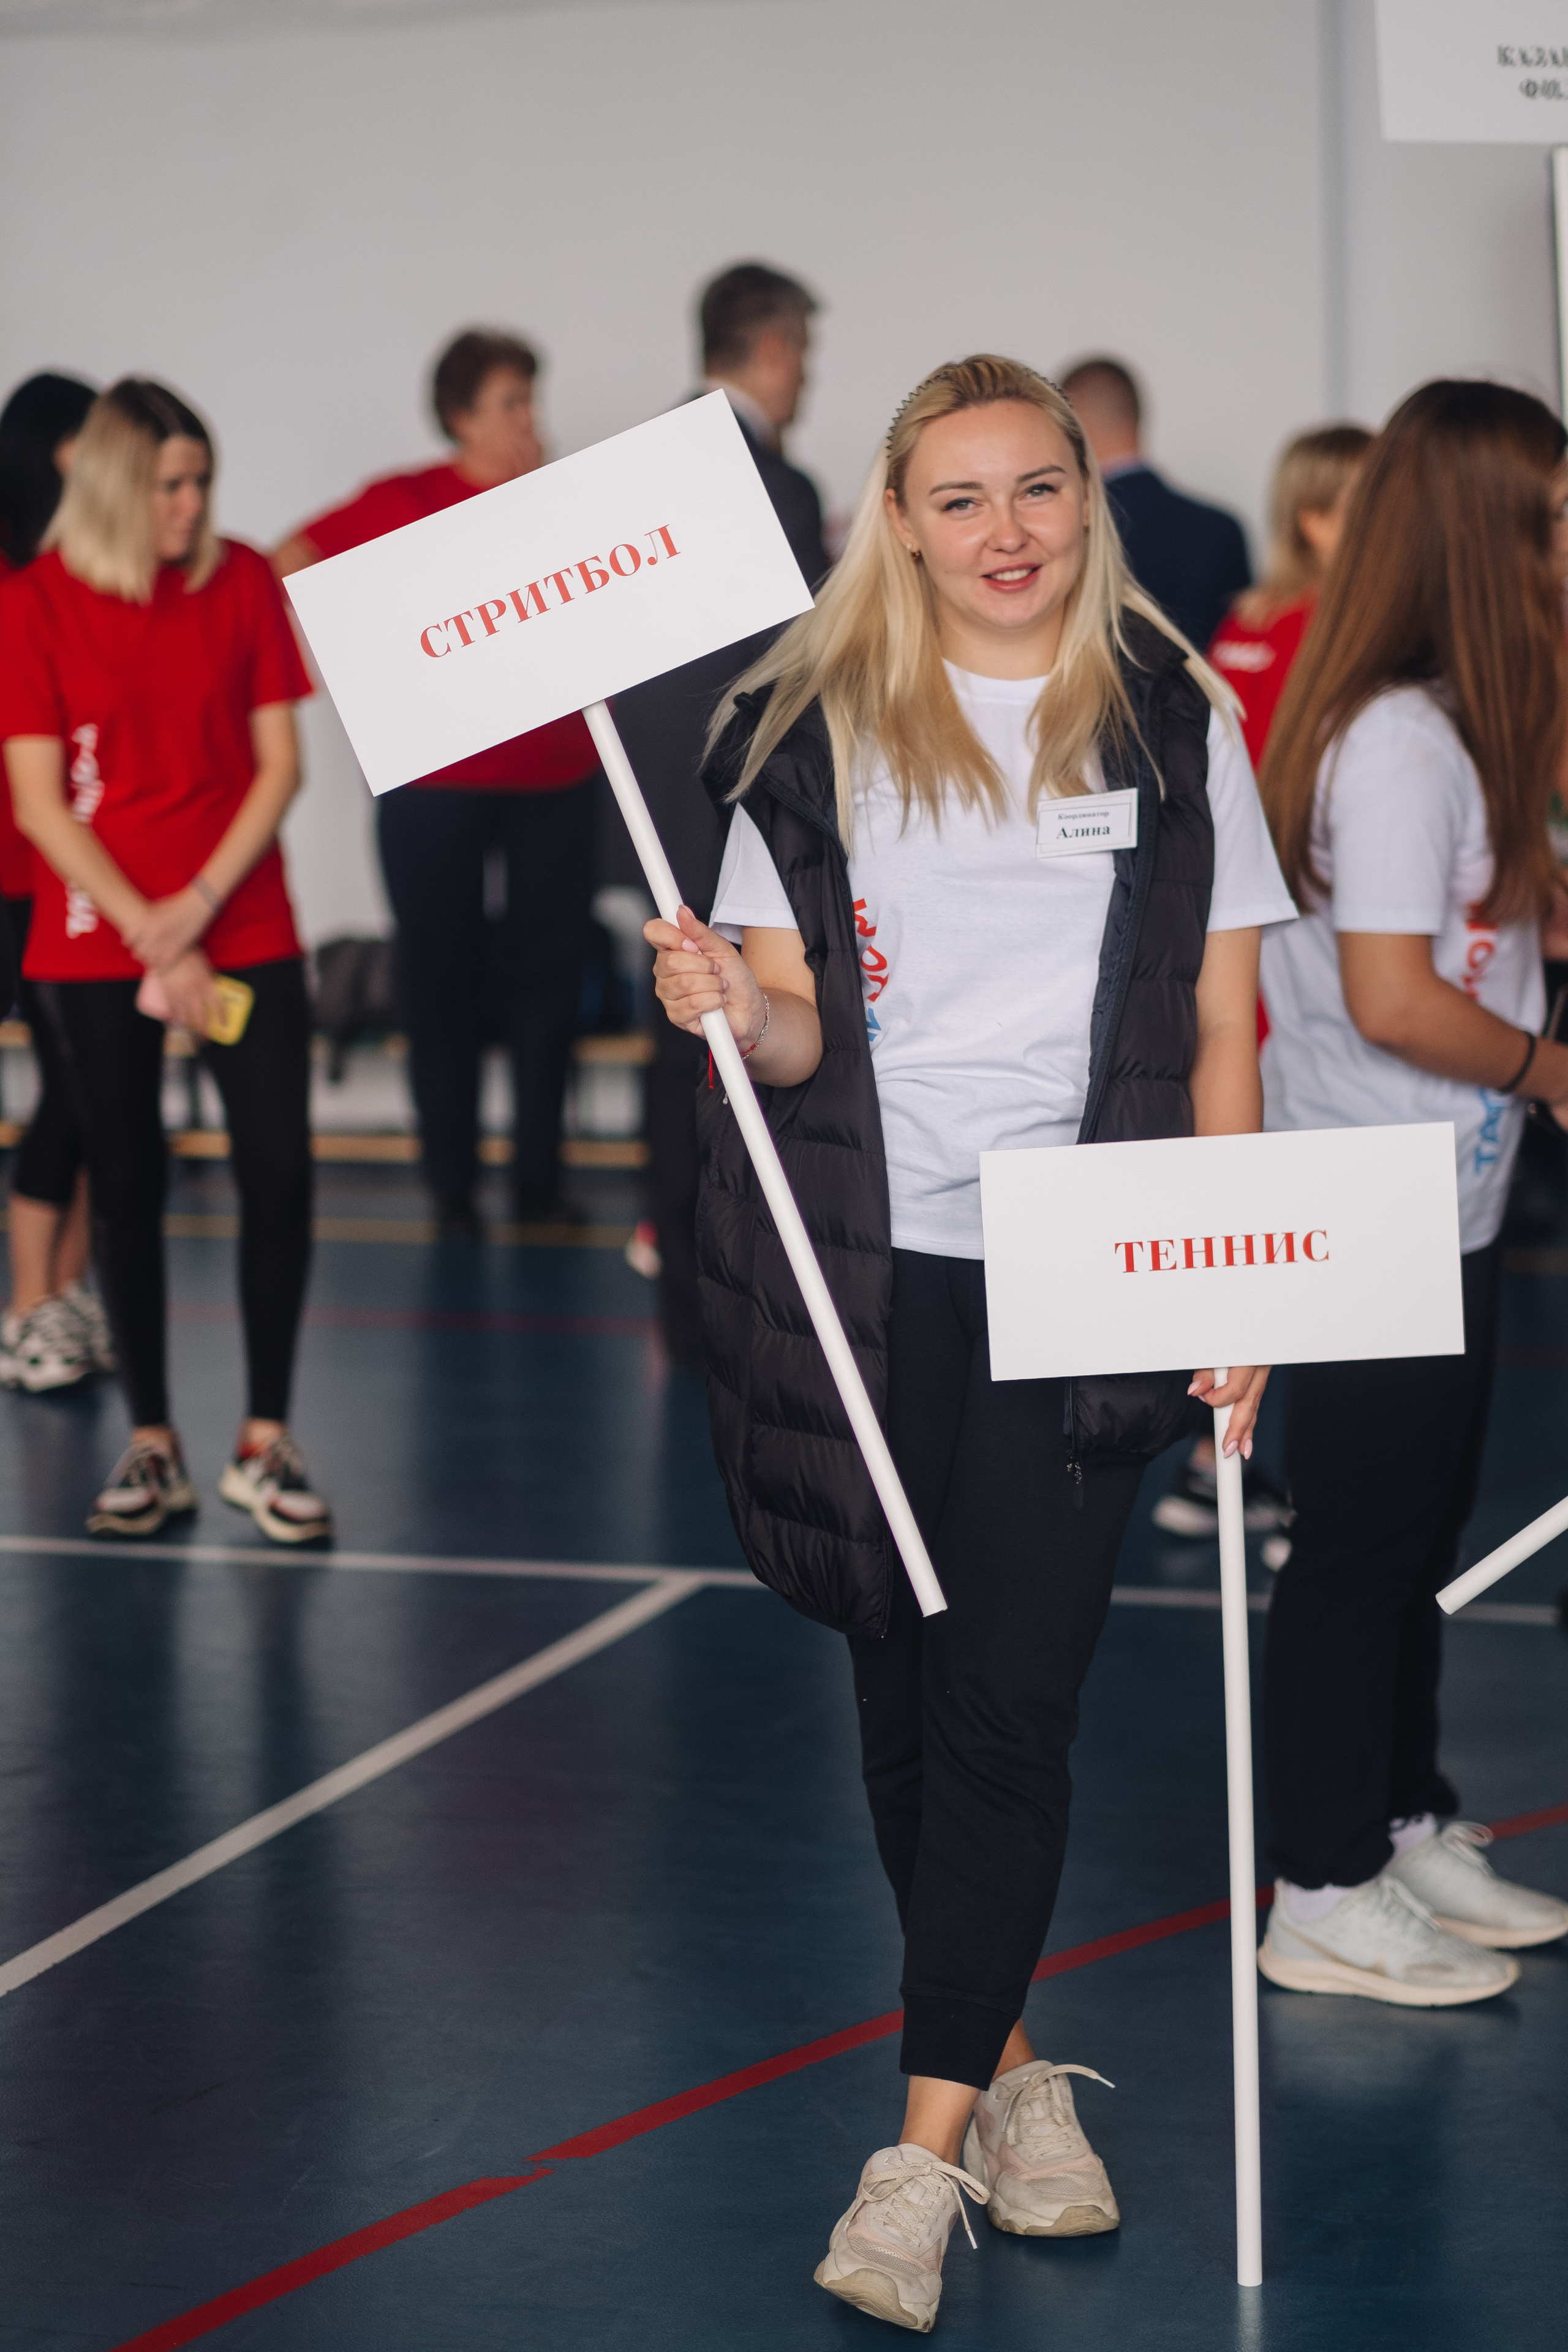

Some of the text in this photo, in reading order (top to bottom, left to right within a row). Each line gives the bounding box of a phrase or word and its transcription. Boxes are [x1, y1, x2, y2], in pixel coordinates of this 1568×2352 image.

[420, 524, 681, 658] СТРИТБОЛ
[1056, 826, 1110, 840] Алина
[1114, 1229, 1329, 1273] ТЕННИС
